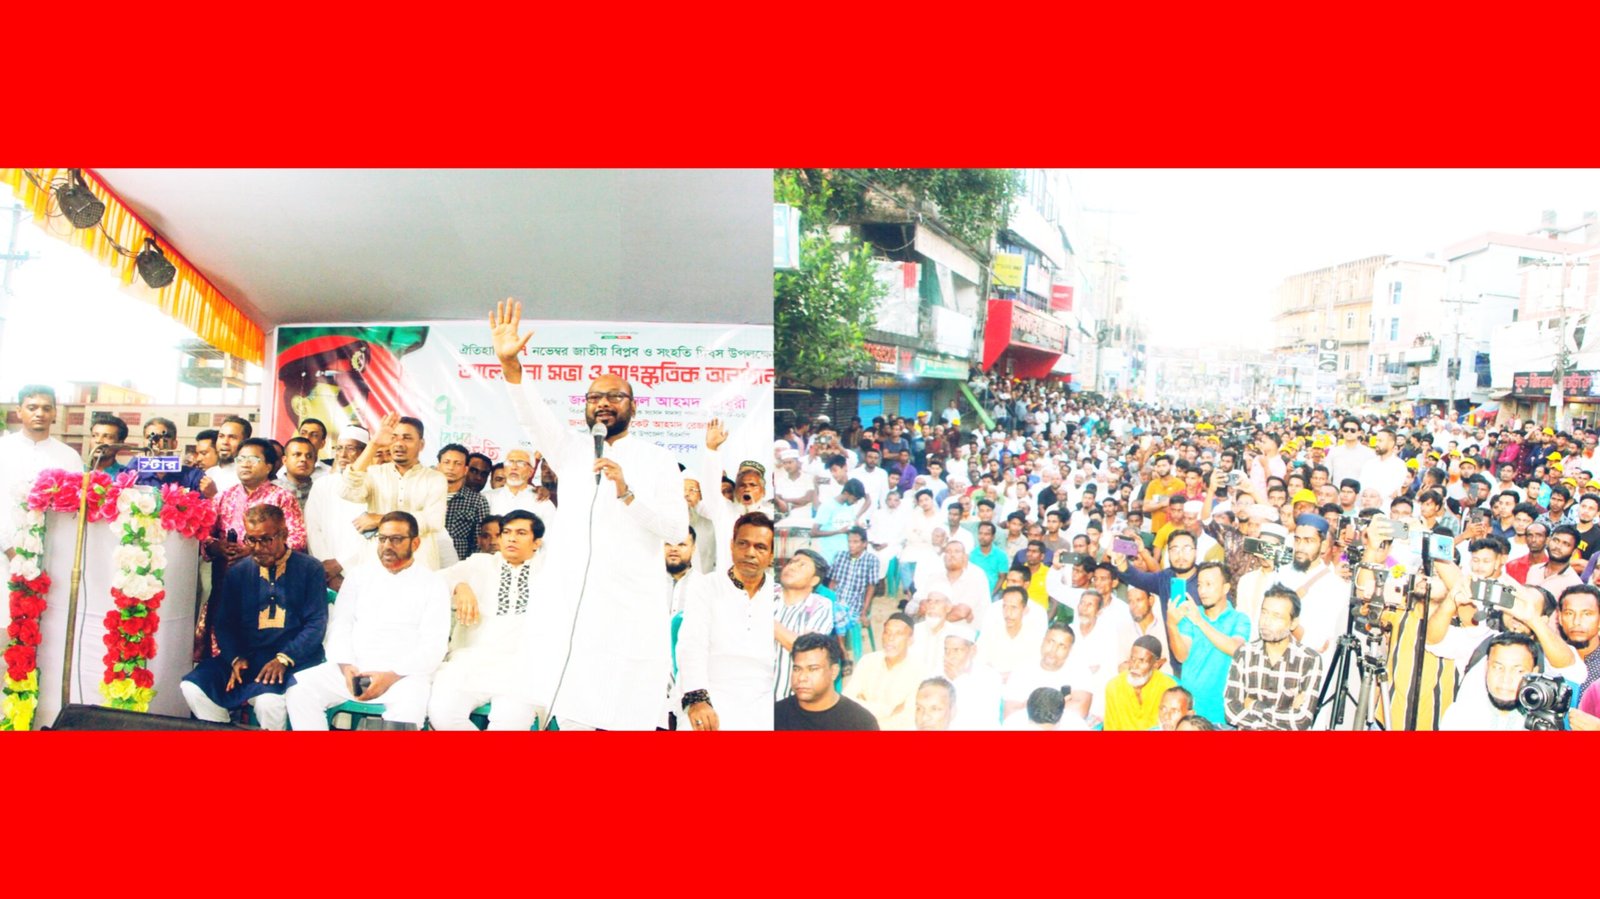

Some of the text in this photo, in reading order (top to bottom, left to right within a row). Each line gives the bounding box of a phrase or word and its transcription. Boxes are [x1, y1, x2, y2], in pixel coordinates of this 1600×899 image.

[532, 346, 569, 357] নভেম্বর
[573, 344, 609, 357] জাতীয়
[611, 344, 639, 358] বিপ্লব
[644, 348, 653, 357] ও
[657, 345, 692, 358] সংহতি
[547, 364, 583, 381] সভা
[588, 365, 602, 380] ও
[608, 361, 700, 388] সাংস্কৃতিক
[655, 396, 702, 408] আহমদ
[433, 394, 453, 426] ৭
[568, 419, 586, 427] জনা
[652, 421, 682, 429] আহমদ
[140, 457, 178, 470] স্টার
